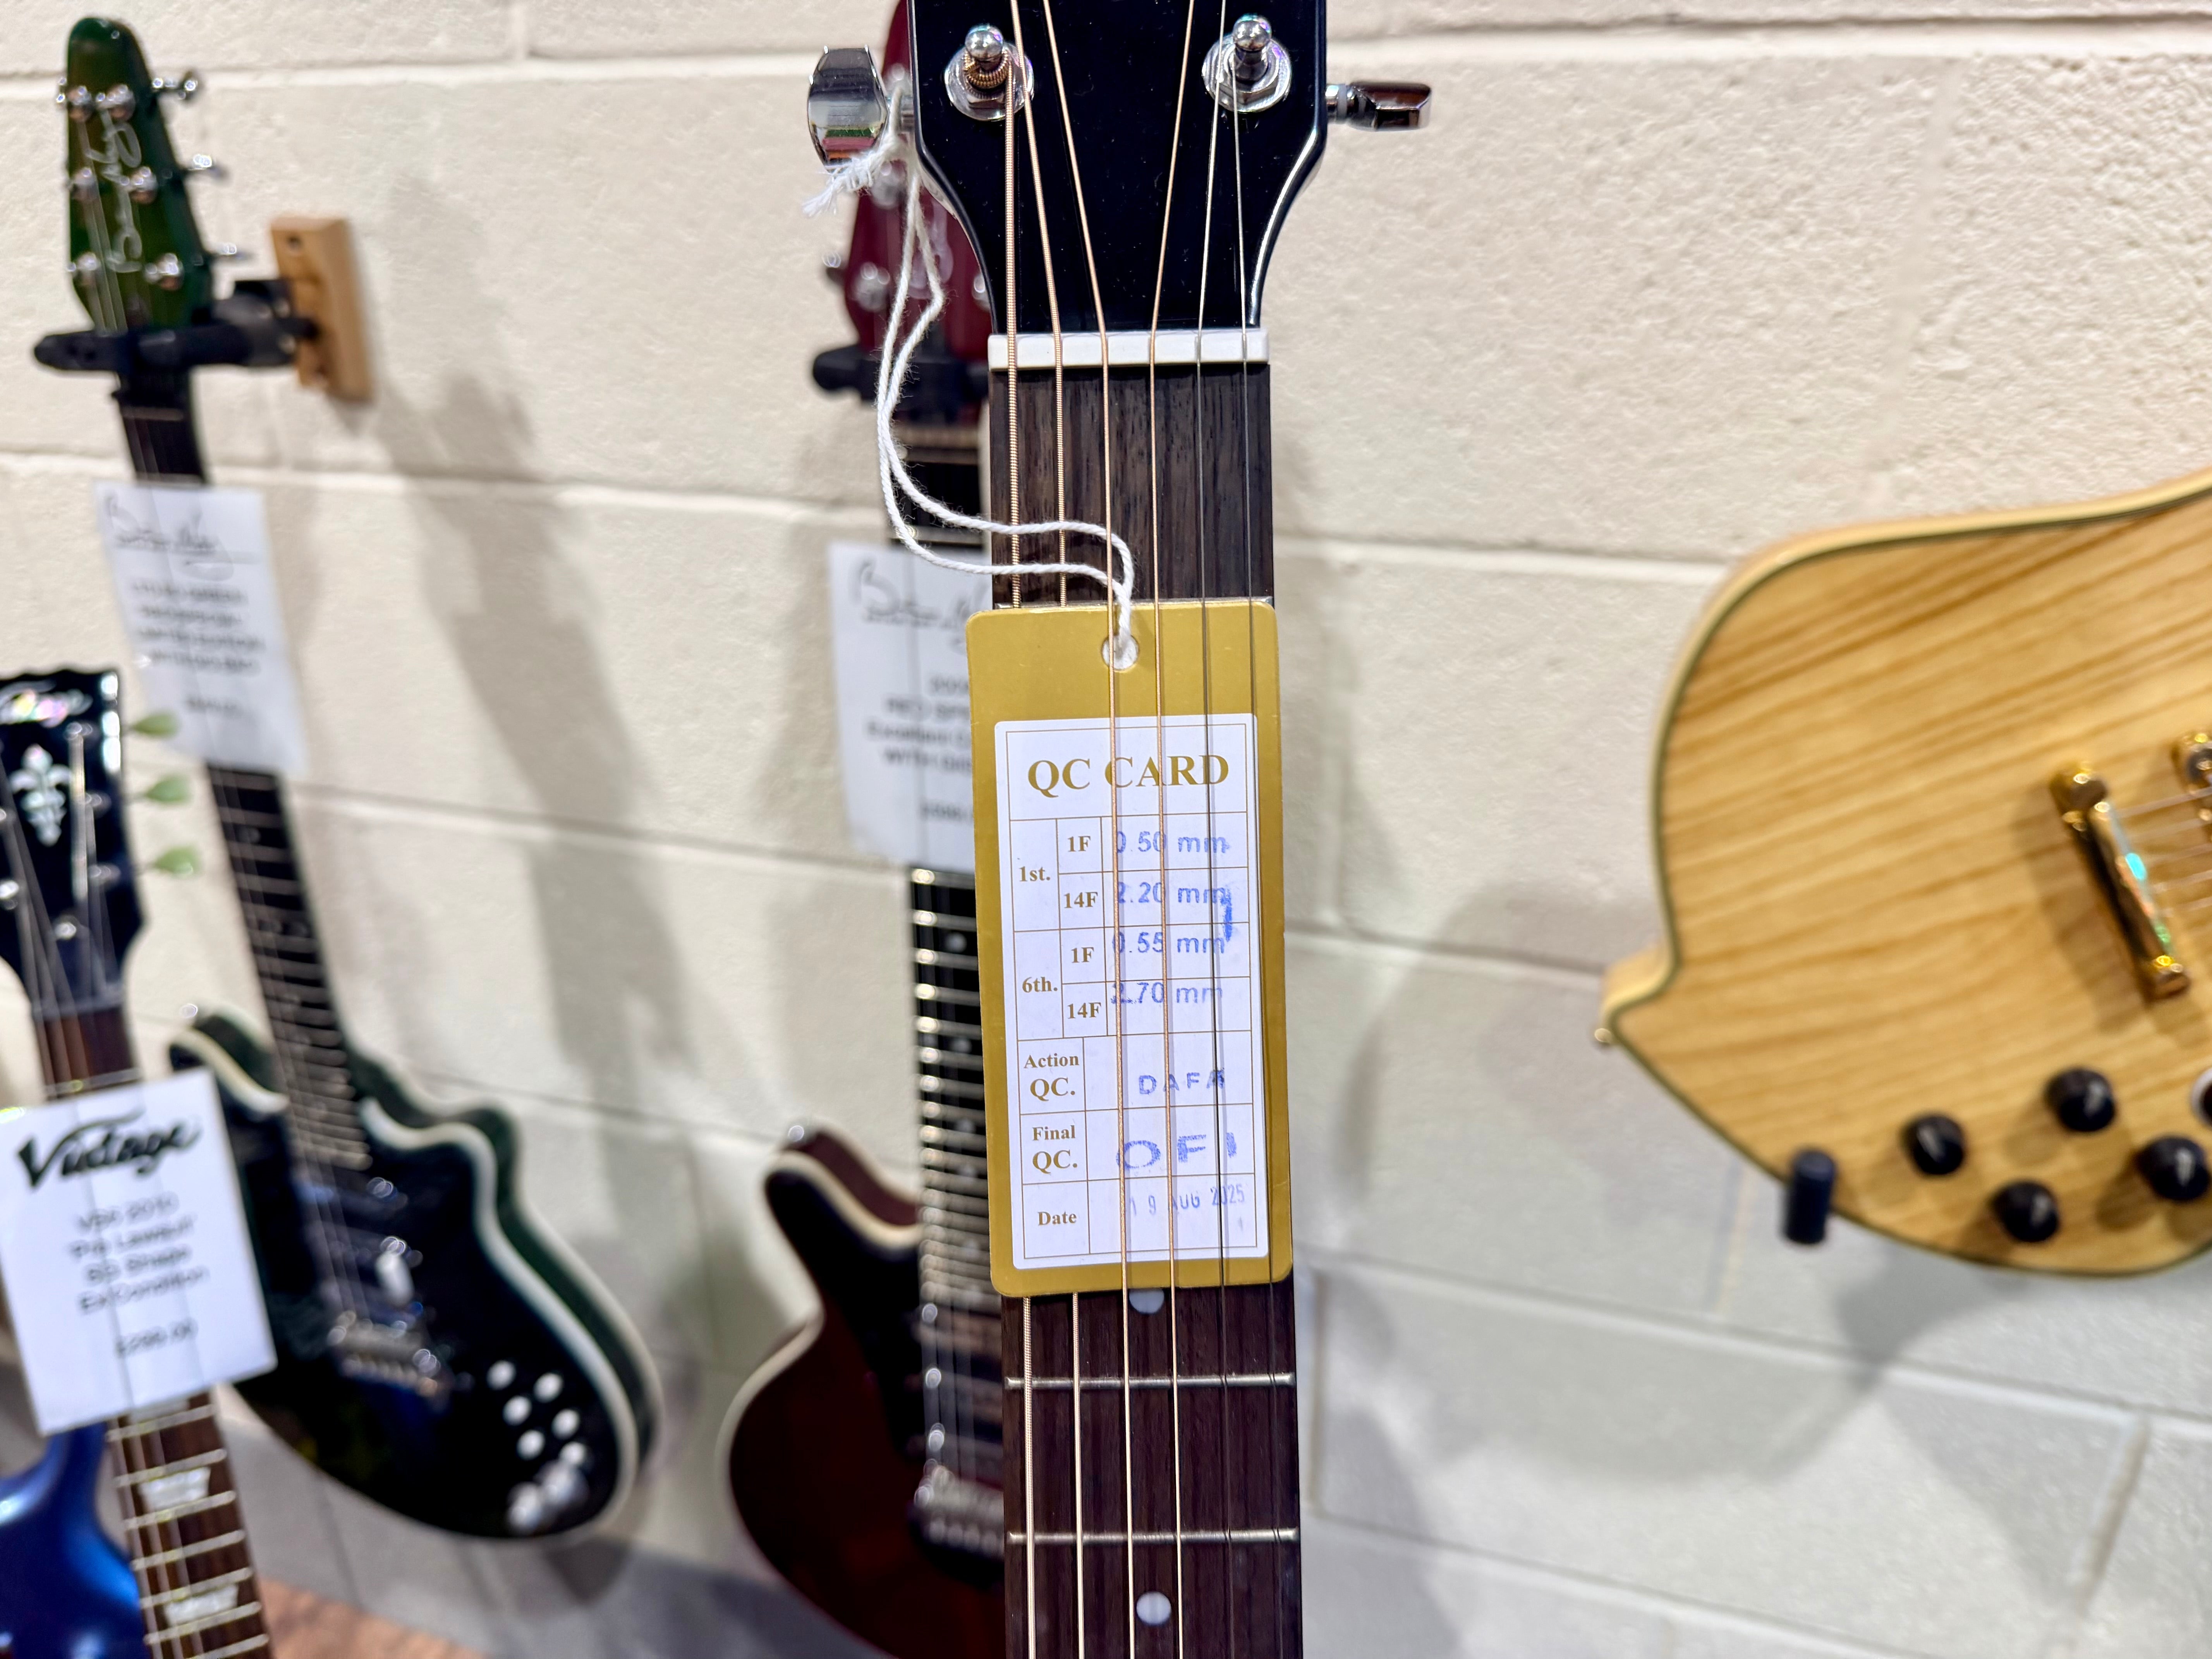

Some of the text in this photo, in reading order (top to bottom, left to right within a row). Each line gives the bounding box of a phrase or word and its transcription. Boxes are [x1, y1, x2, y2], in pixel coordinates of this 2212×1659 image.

[1028, 754, 1229, 798] QC CARD
[1067, 831, 1228, 853] 1F 0.50 mm
[1019, 865, 1051, 881] 1st.
[1063, 881, 1229, 908] 14F 2.20 mm
[1071, 931, 1225, 963] 1F 0.55 mm
[1022, 976, 1058, 992] 6th.
[1066, 1002, 1101, 1019] 14F
[1176, 987, 1223, 1004] mm
[1024, 1053, 1080, 1069] Action
[1030, 1077, 1075, 1102] QC.
[1032, 1125, 1075, 1141] Final
[1032, 1149, 1077, 1175] QC.
[1038, 1211, 1077, 1226] Date
